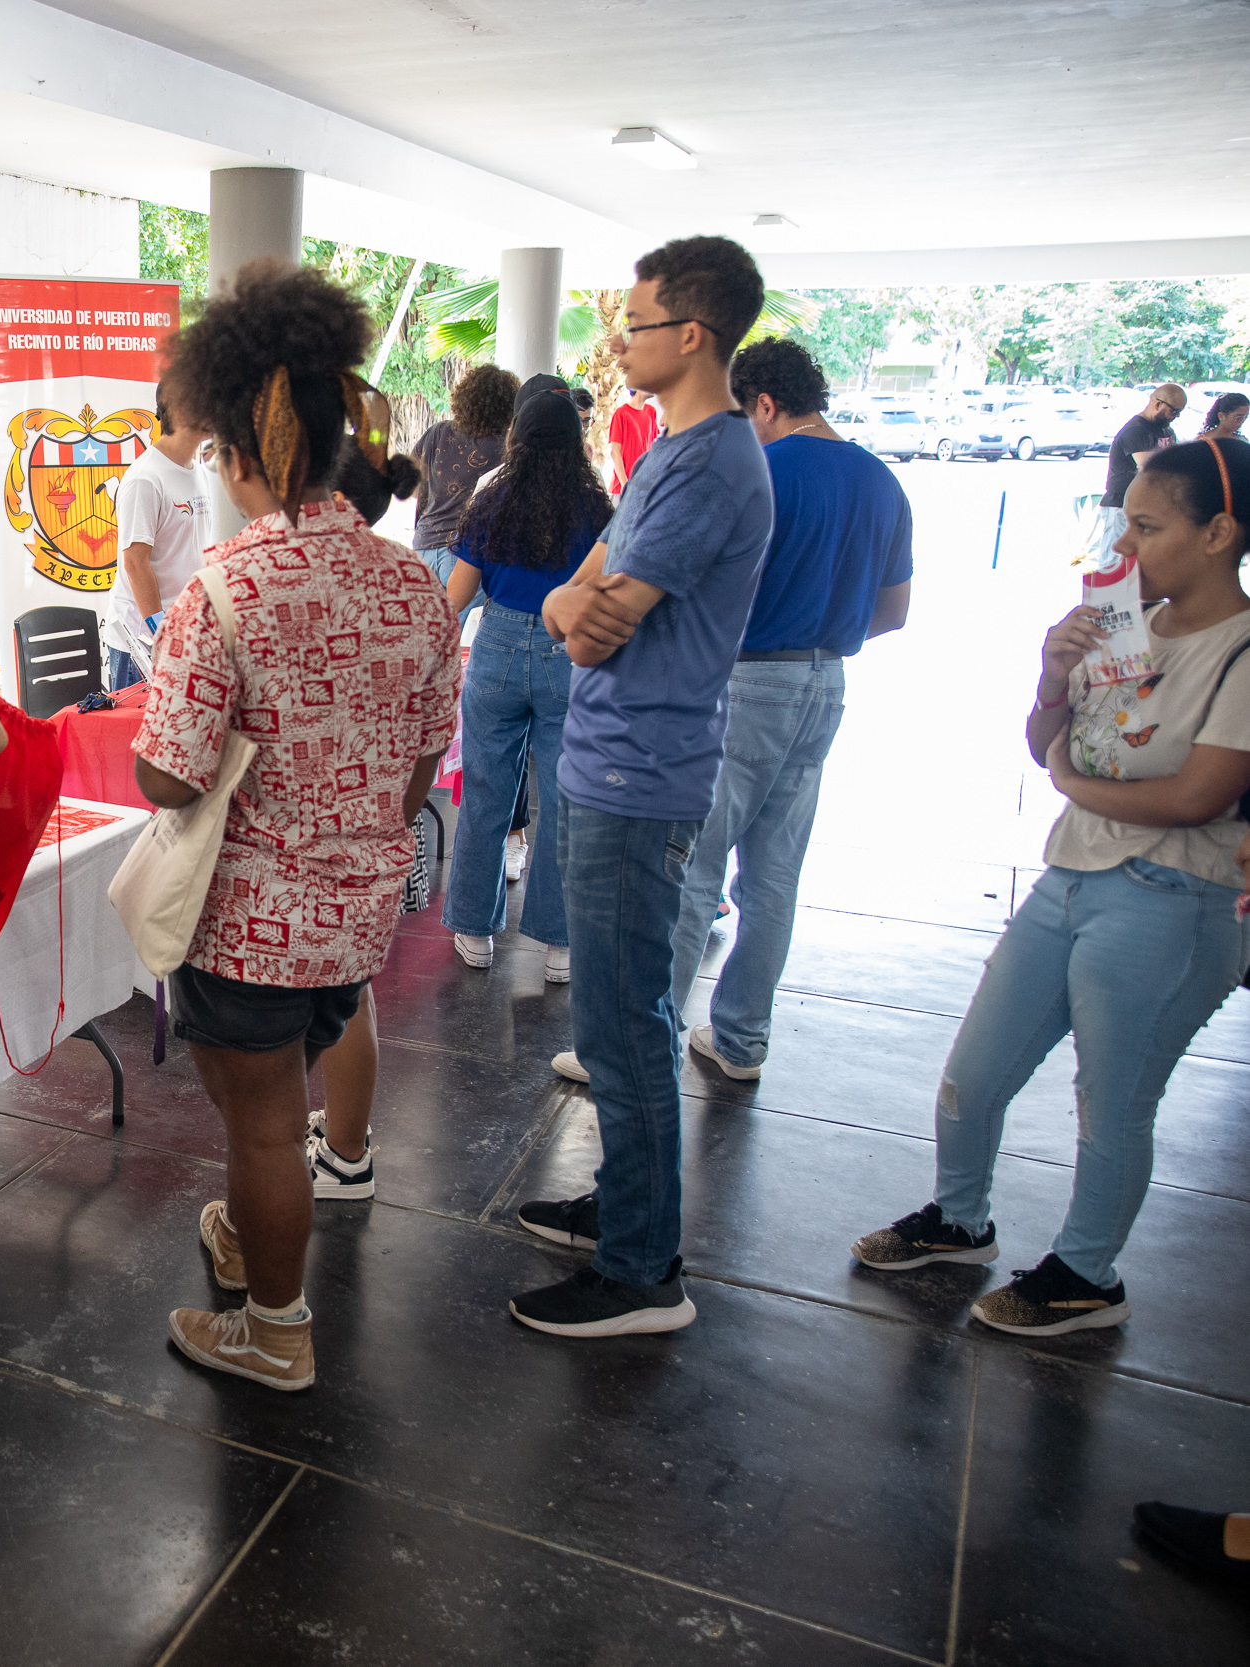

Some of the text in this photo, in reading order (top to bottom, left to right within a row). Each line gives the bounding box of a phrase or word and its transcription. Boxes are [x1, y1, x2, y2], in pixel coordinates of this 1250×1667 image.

[76, 310, 92, 325] DE
[94, 311, 140, 326] PUERTO
[143, 312, 171, 327] RICO
[8, 332, 157, 351] RECINTO DE RÍO PIEDRAS
